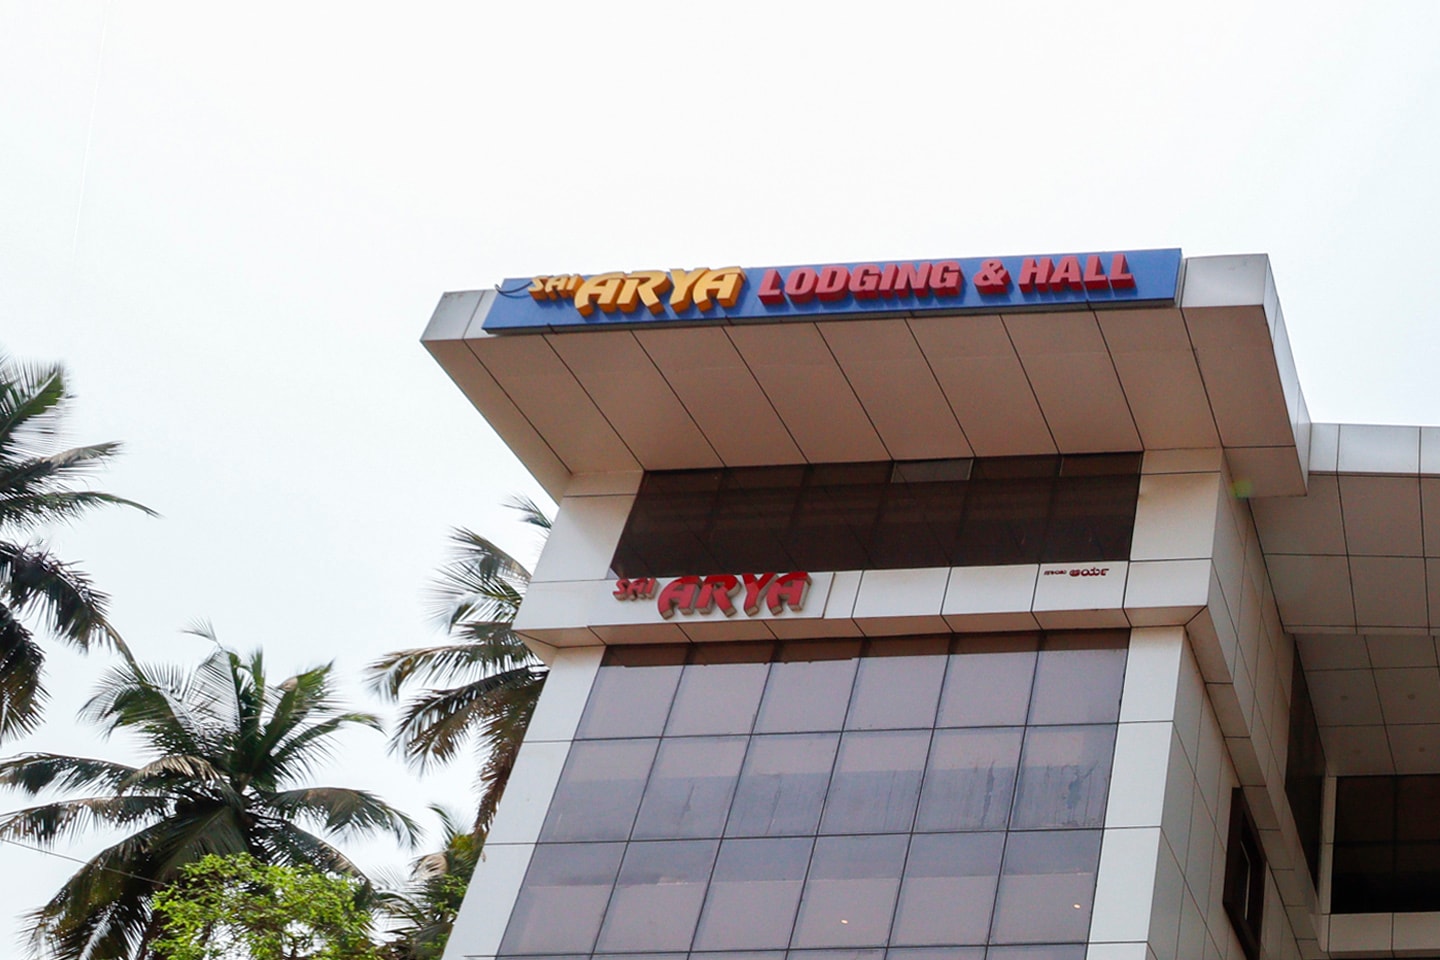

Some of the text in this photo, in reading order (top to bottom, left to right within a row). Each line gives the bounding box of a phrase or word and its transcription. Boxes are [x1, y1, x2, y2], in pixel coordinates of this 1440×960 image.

[528, 254, 1137, 316] SAI ARYA LODGING & HALL
[613, 571, 812, 620] SAI ARYA
